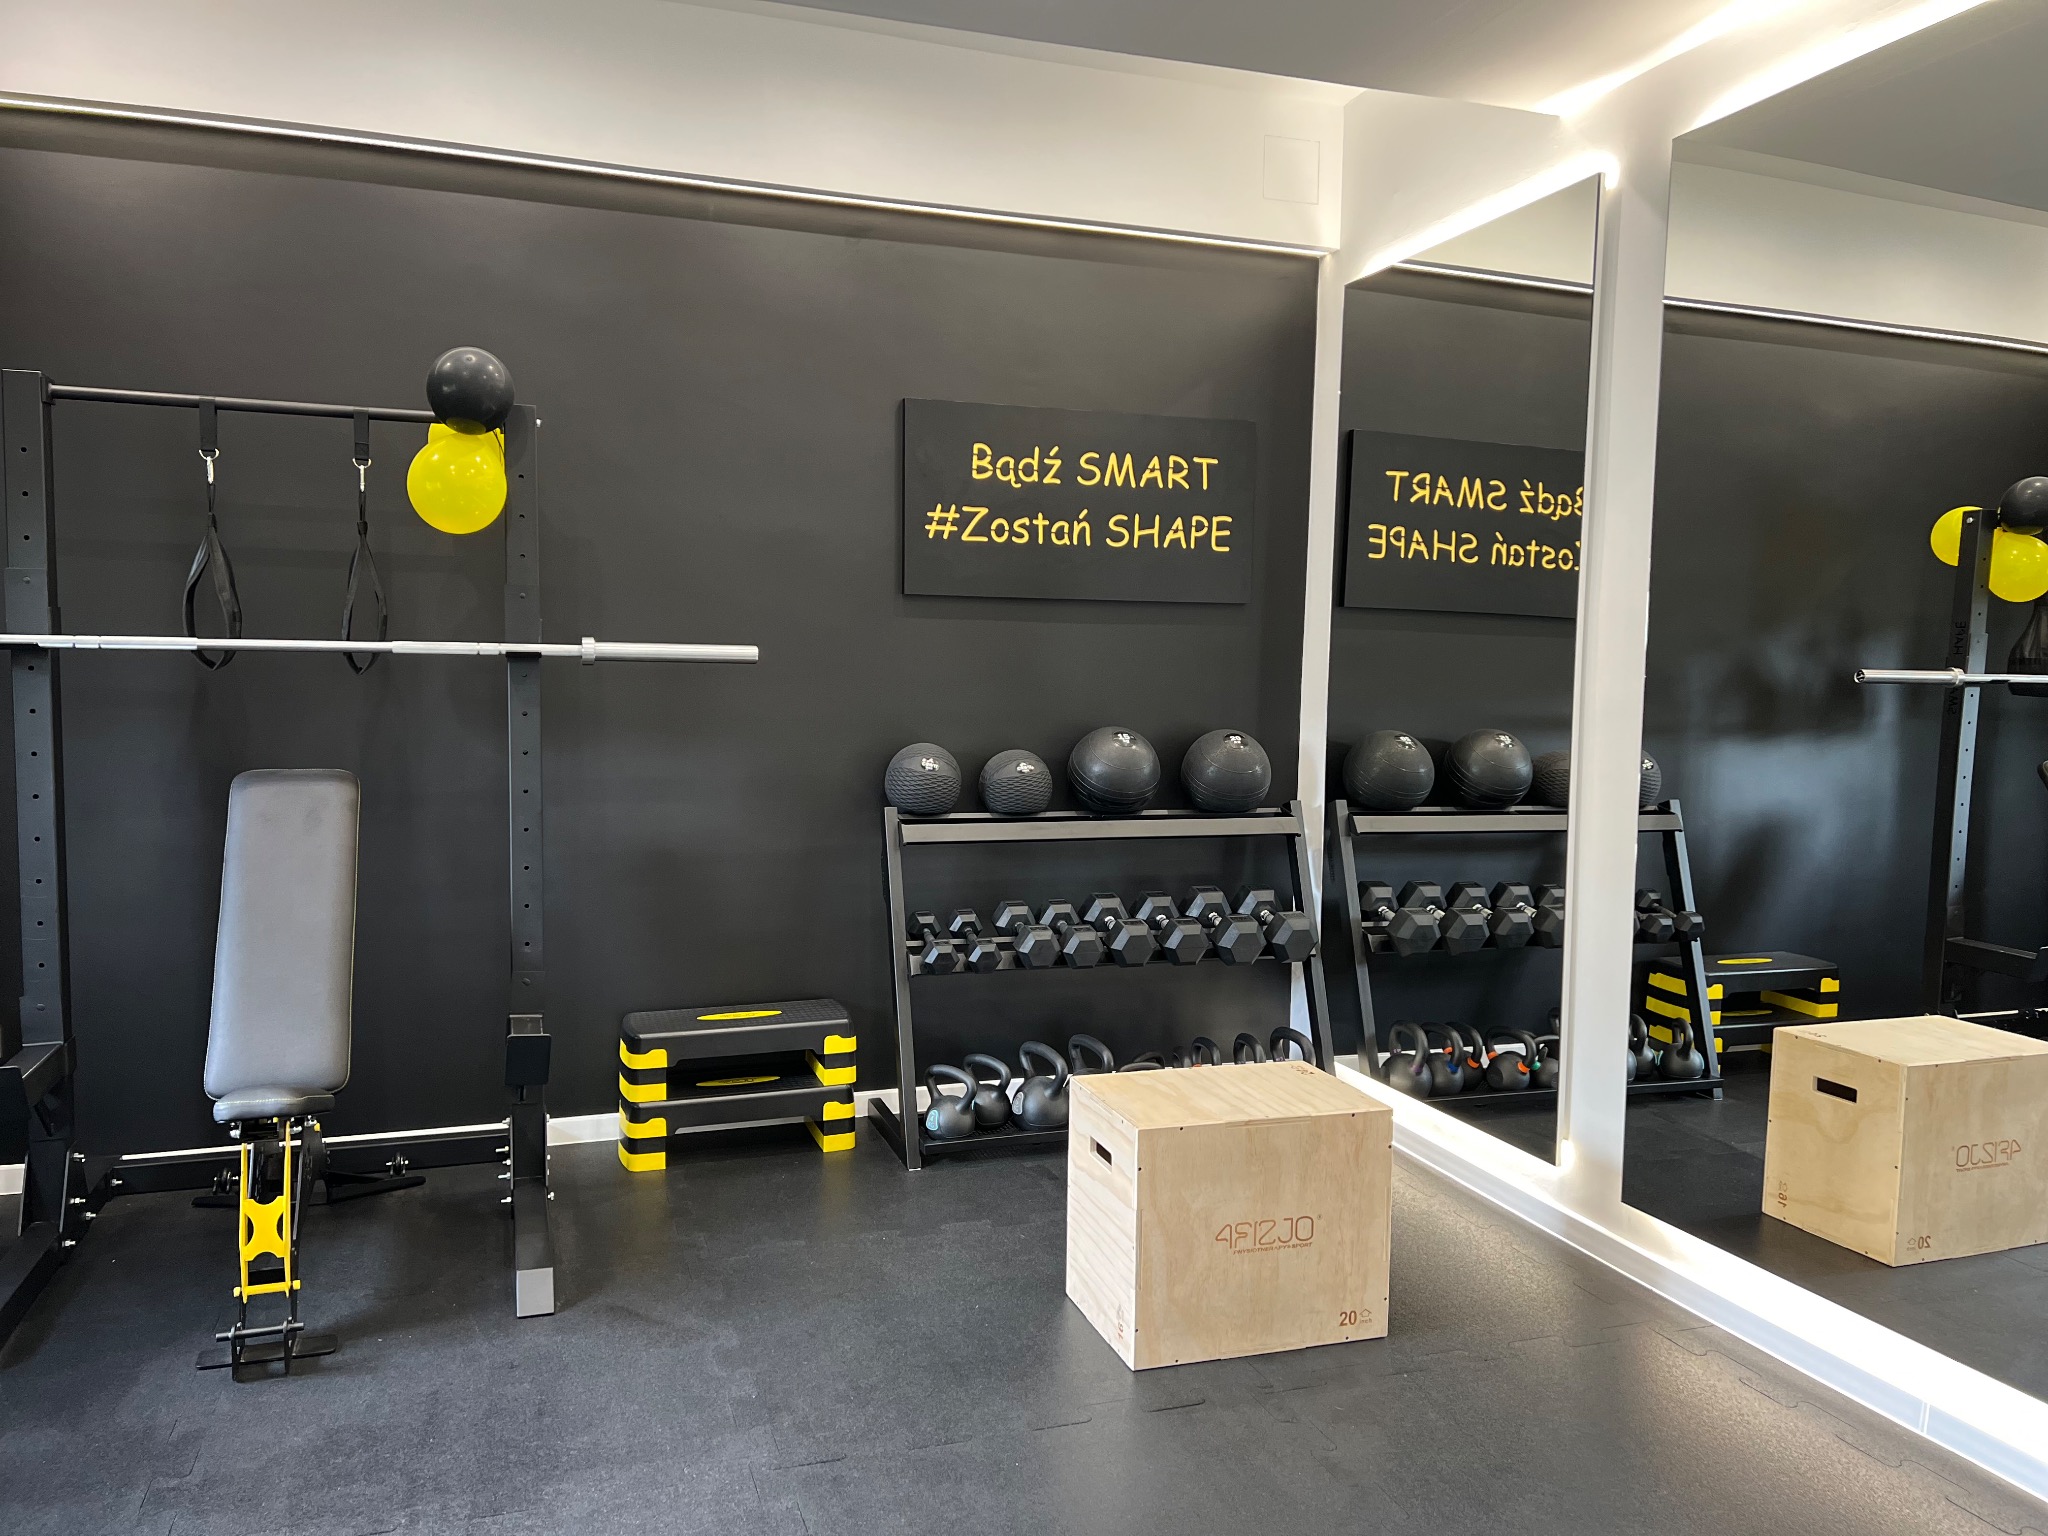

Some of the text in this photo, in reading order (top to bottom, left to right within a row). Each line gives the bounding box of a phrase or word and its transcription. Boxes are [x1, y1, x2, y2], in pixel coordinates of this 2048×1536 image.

[971, 442, 1219, 491] Bądź SMART
[925, 503, 1233, 553] #Zostań SHAPE
[1215, 1215, 1314, 1249] 4FIZJO
[1338, 1310, 1357, 1327] 20
